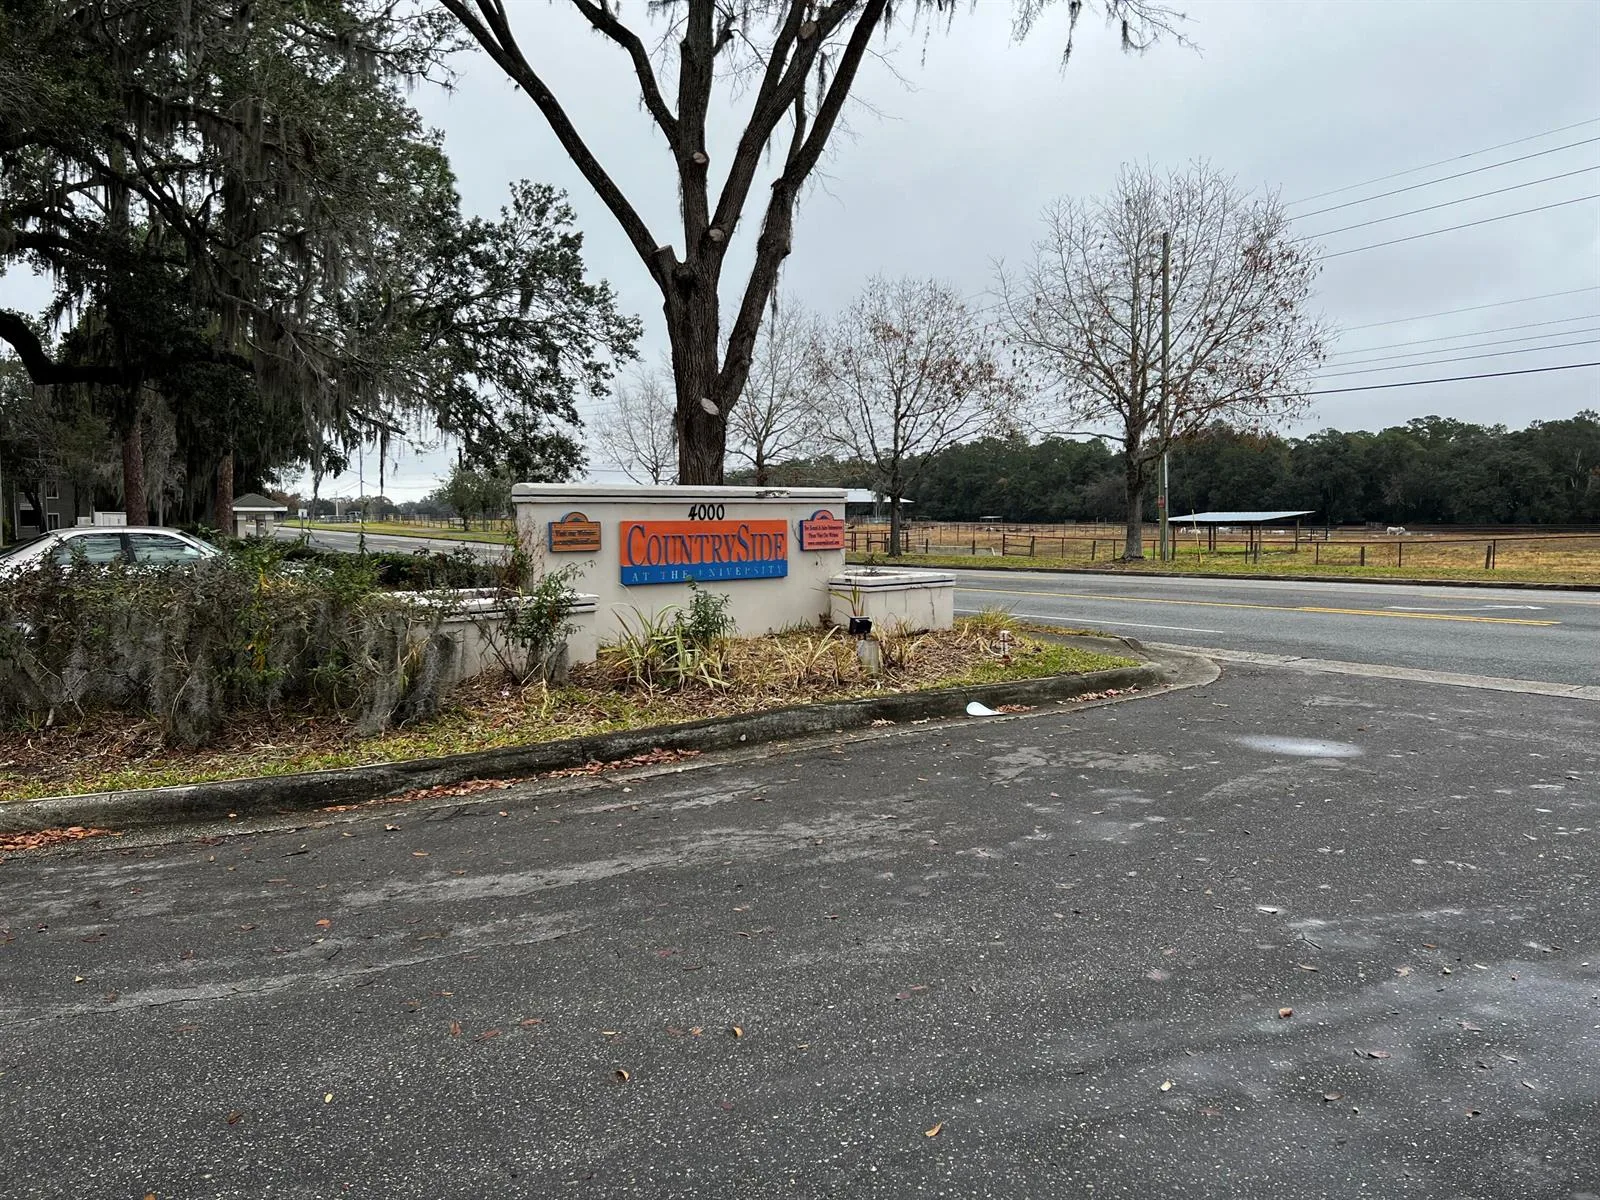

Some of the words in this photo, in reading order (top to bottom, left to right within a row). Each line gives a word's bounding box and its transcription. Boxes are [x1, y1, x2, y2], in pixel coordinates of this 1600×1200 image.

[688, 504, 725, 520] 4000
[627, 524, 785, 567] COUNTRYSIDE
[632, 571, 650, 582] AT
[660, 569, 689, 580] THE
